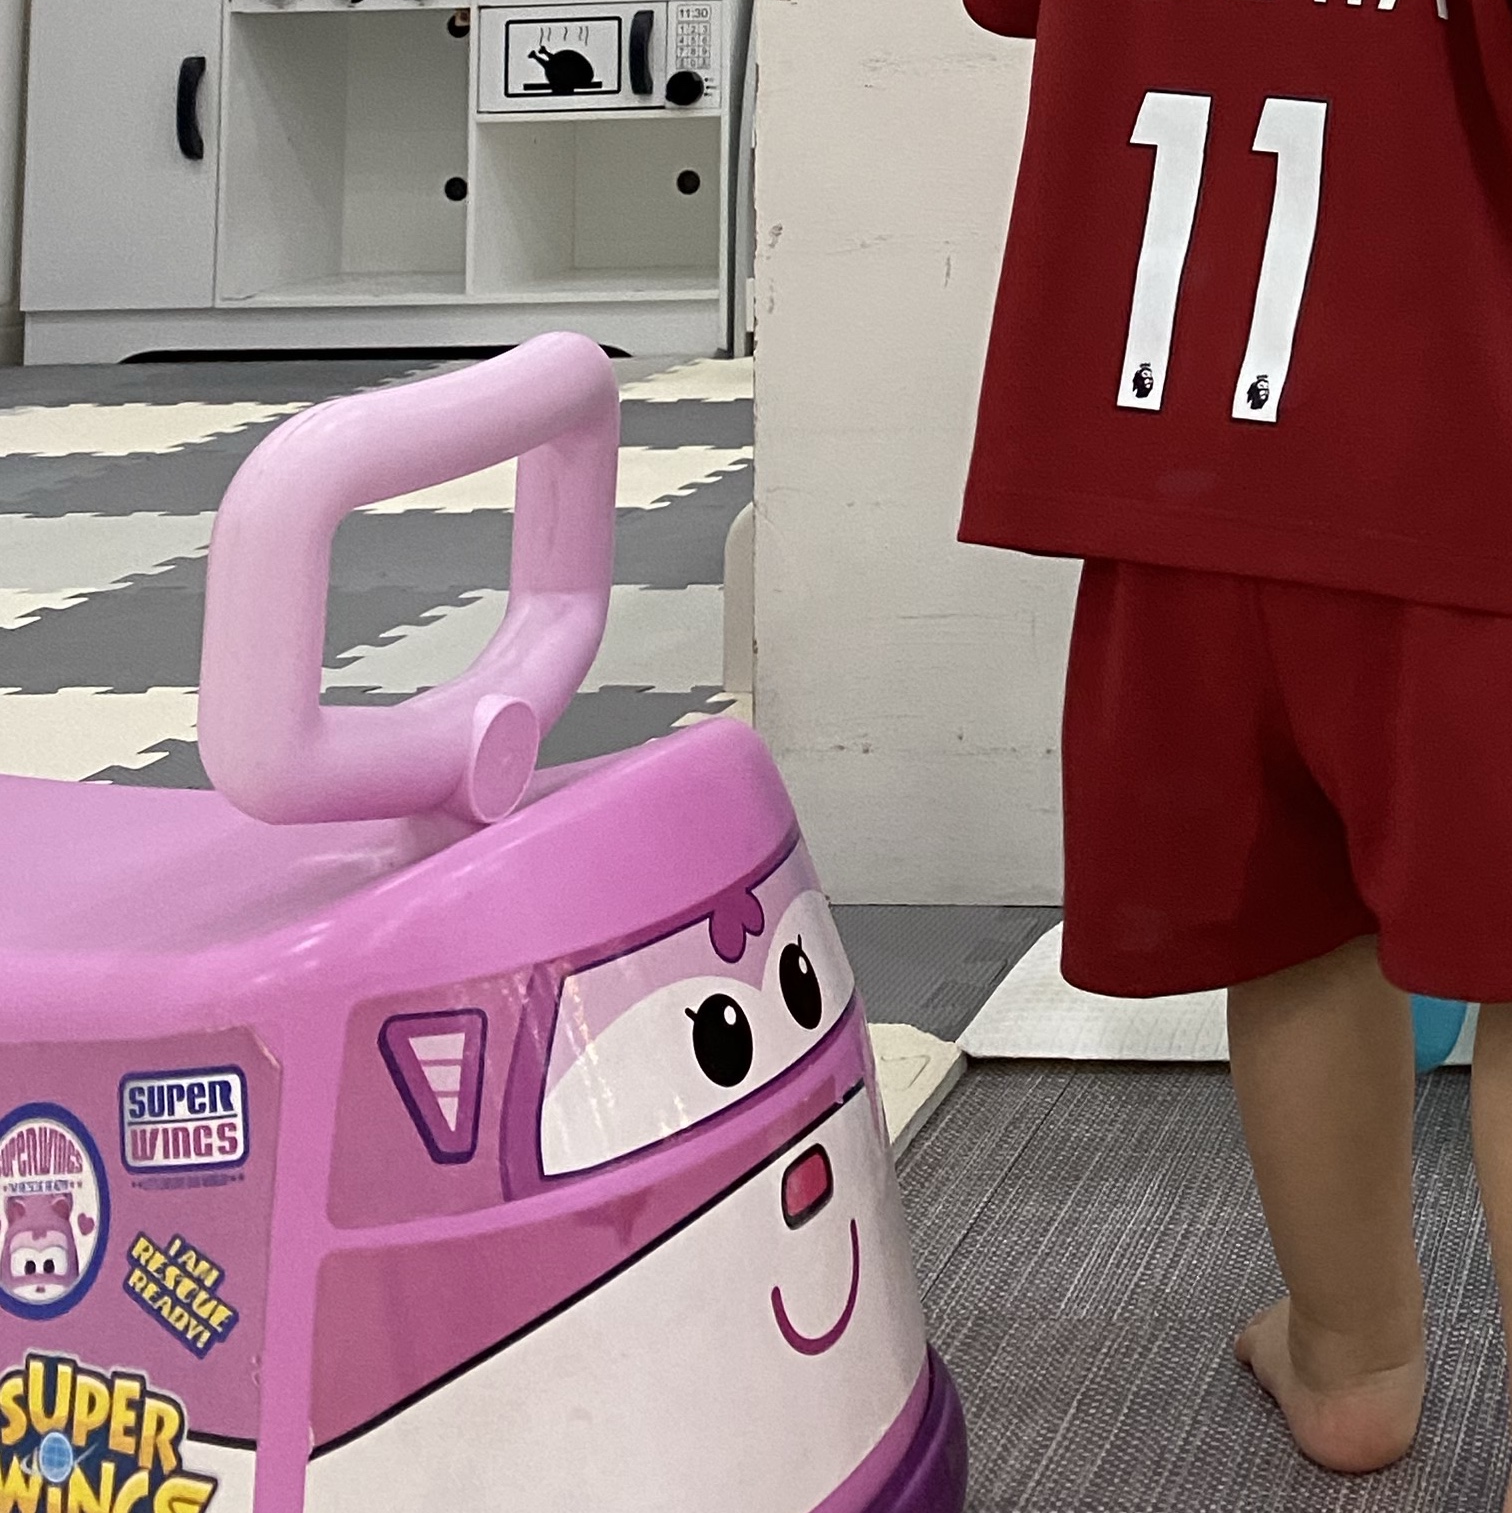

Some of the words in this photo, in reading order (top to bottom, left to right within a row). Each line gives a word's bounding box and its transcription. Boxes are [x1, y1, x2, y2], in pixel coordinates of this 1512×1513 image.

[1116, 91, 1328, 424] 11
[128, 1079, 235, 1119] SUPER
[128, 1268, 212, 1349] READY!
[131, 1237, 234, 1333] RESCUE
[178, 1250, 220, 1288] AM
[0, 1359, 178, 1475] SUPER
